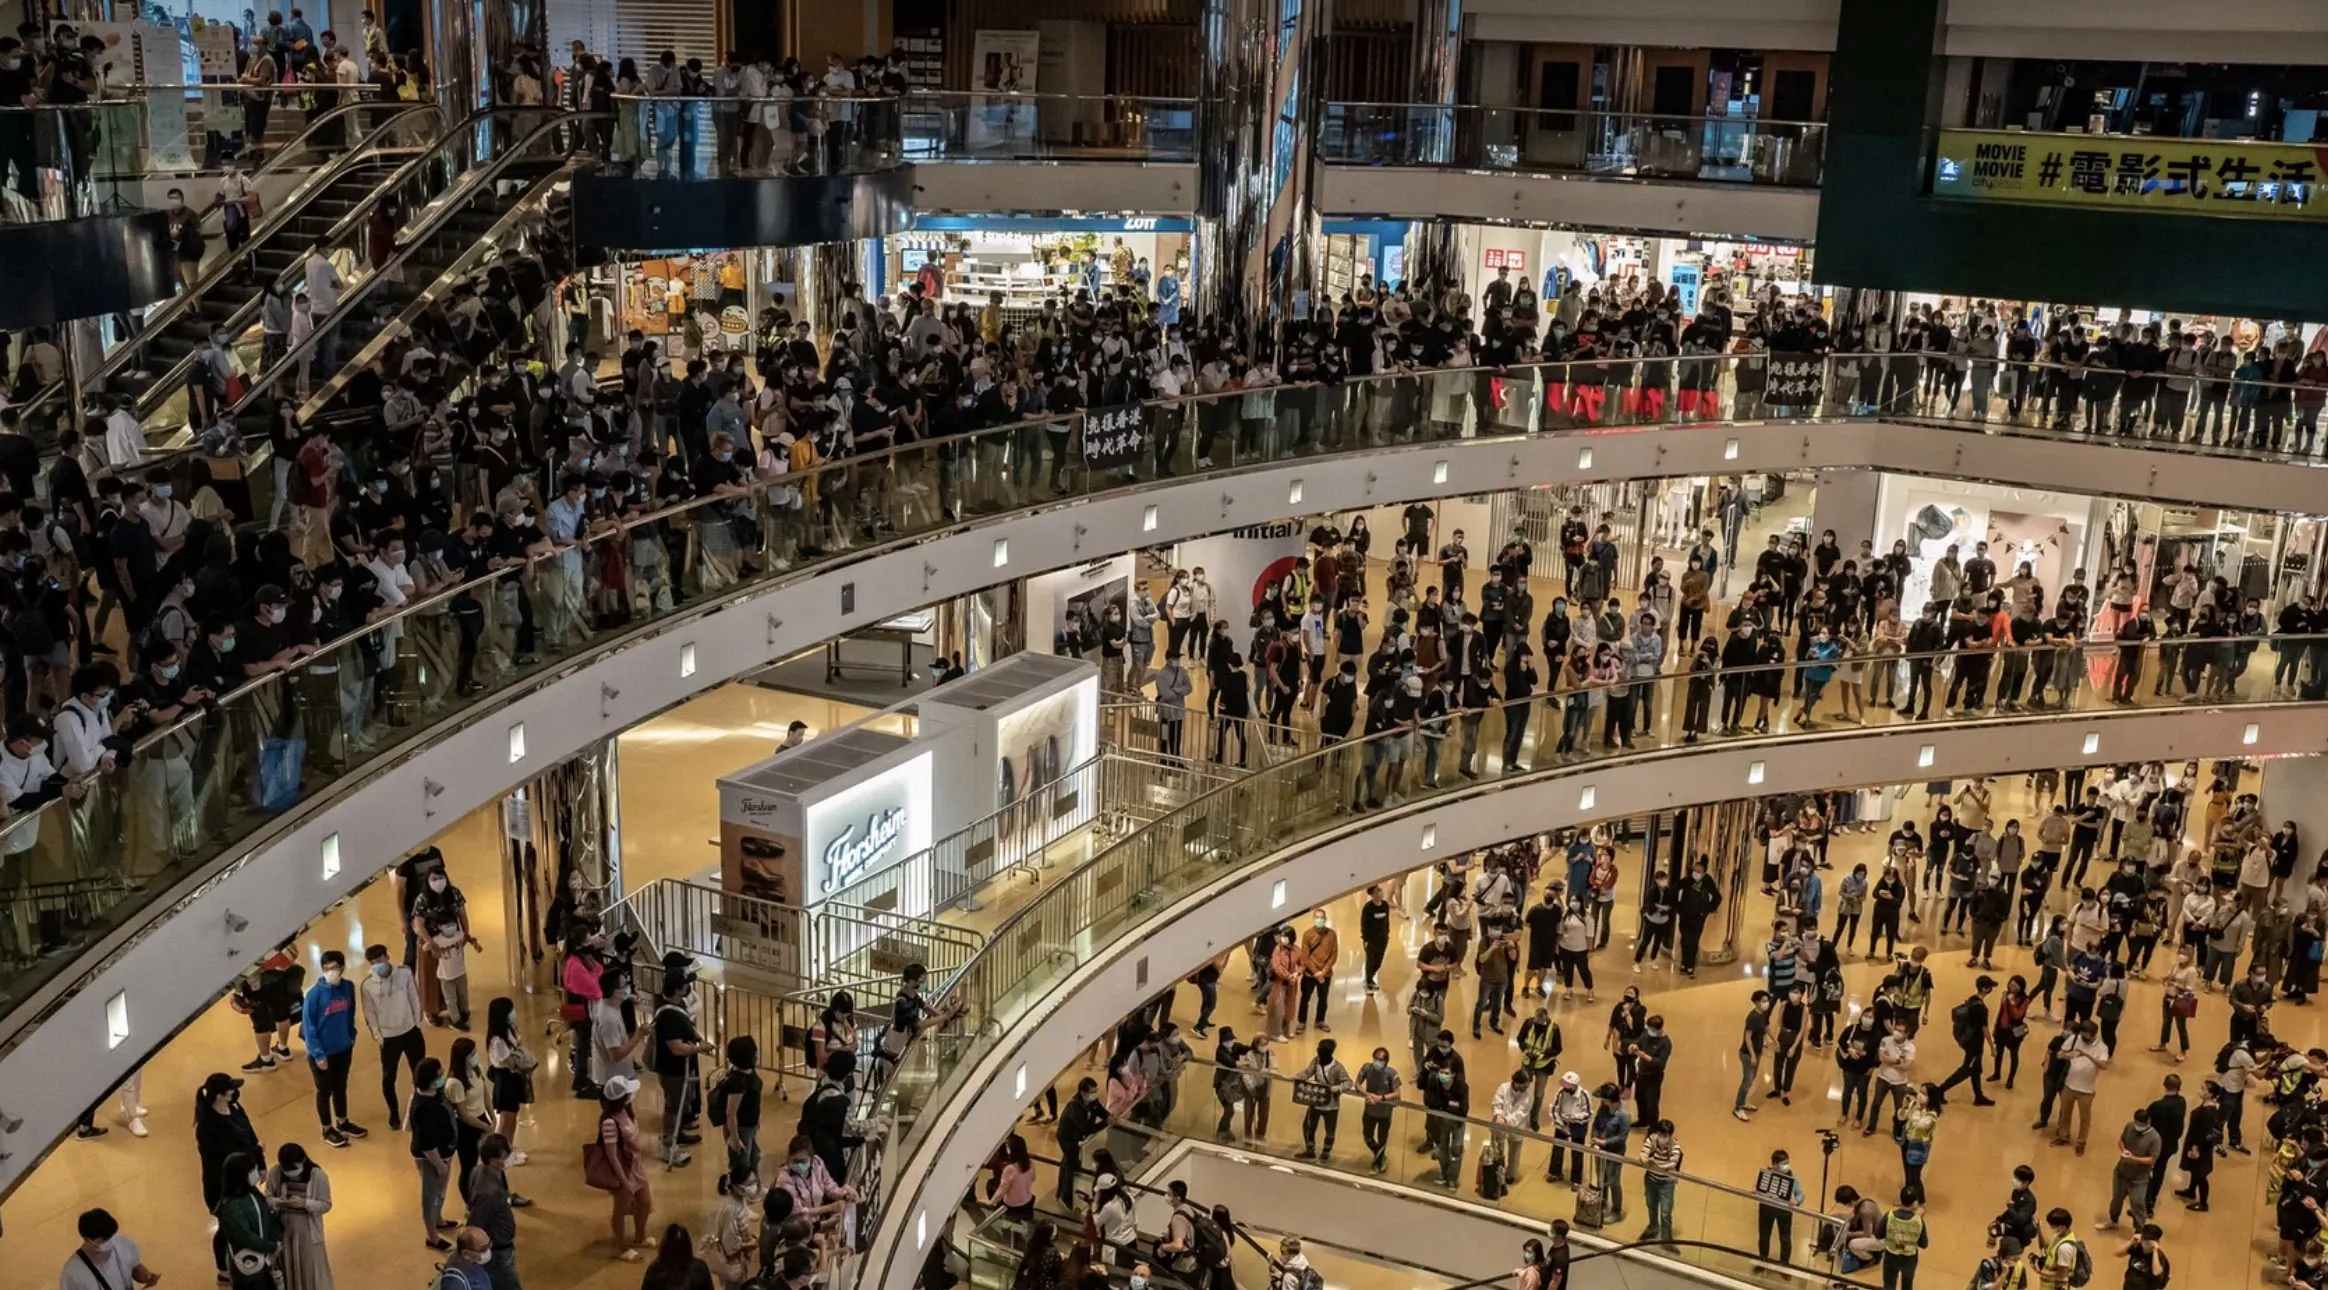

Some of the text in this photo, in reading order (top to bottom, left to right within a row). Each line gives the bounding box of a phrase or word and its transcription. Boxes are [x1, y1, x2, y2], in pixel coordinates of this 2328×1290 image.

[1976, 144, 2027, 161] MOVIE
[1974, 161, 2025, 178] MOVIE
[1086, 430, 1143, 459] 時代革命
[821, 806, 908, 893] Florsheim
